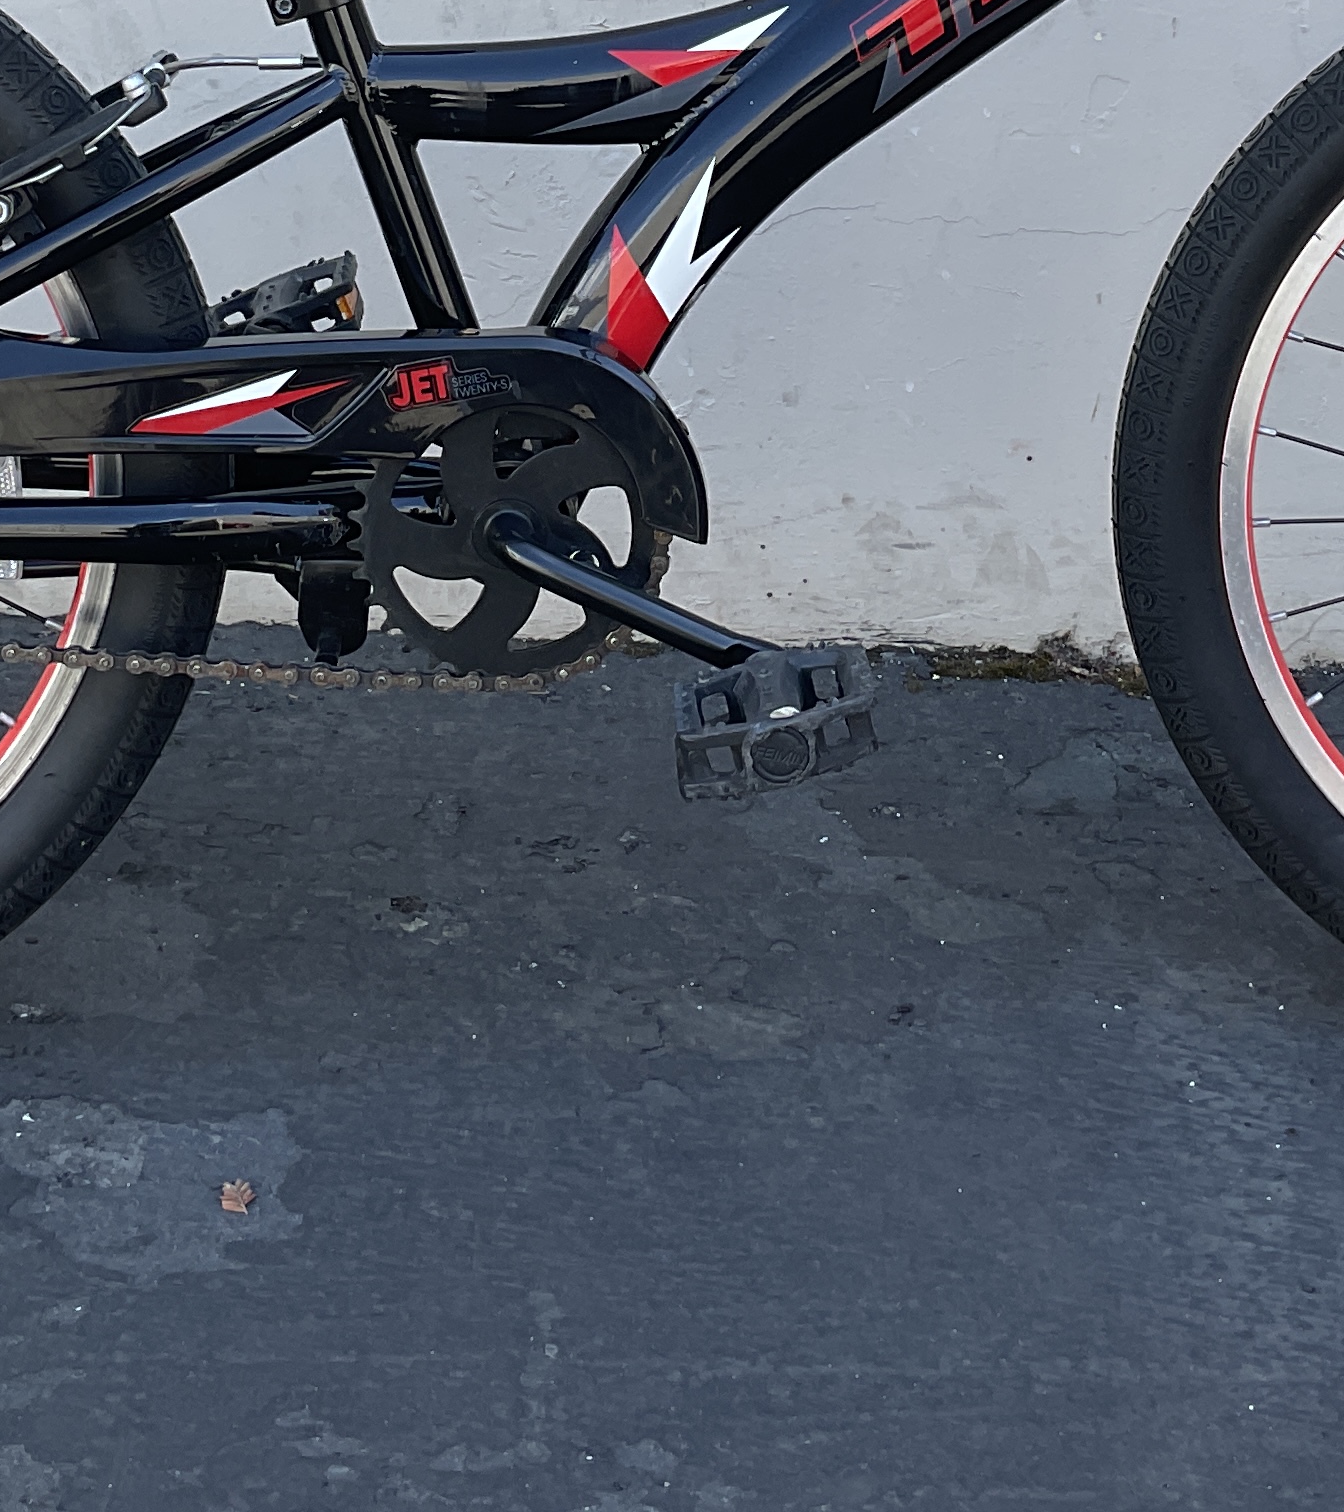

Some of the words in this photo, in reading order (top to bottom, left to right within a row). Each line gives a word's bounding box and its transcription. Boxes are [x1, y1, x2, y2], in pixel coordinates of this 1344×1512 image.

[392, 364, 449, 407] JET
[451, 372, 488, 388] SERIES
[452, 378, 508, 399] TWENTY-S
